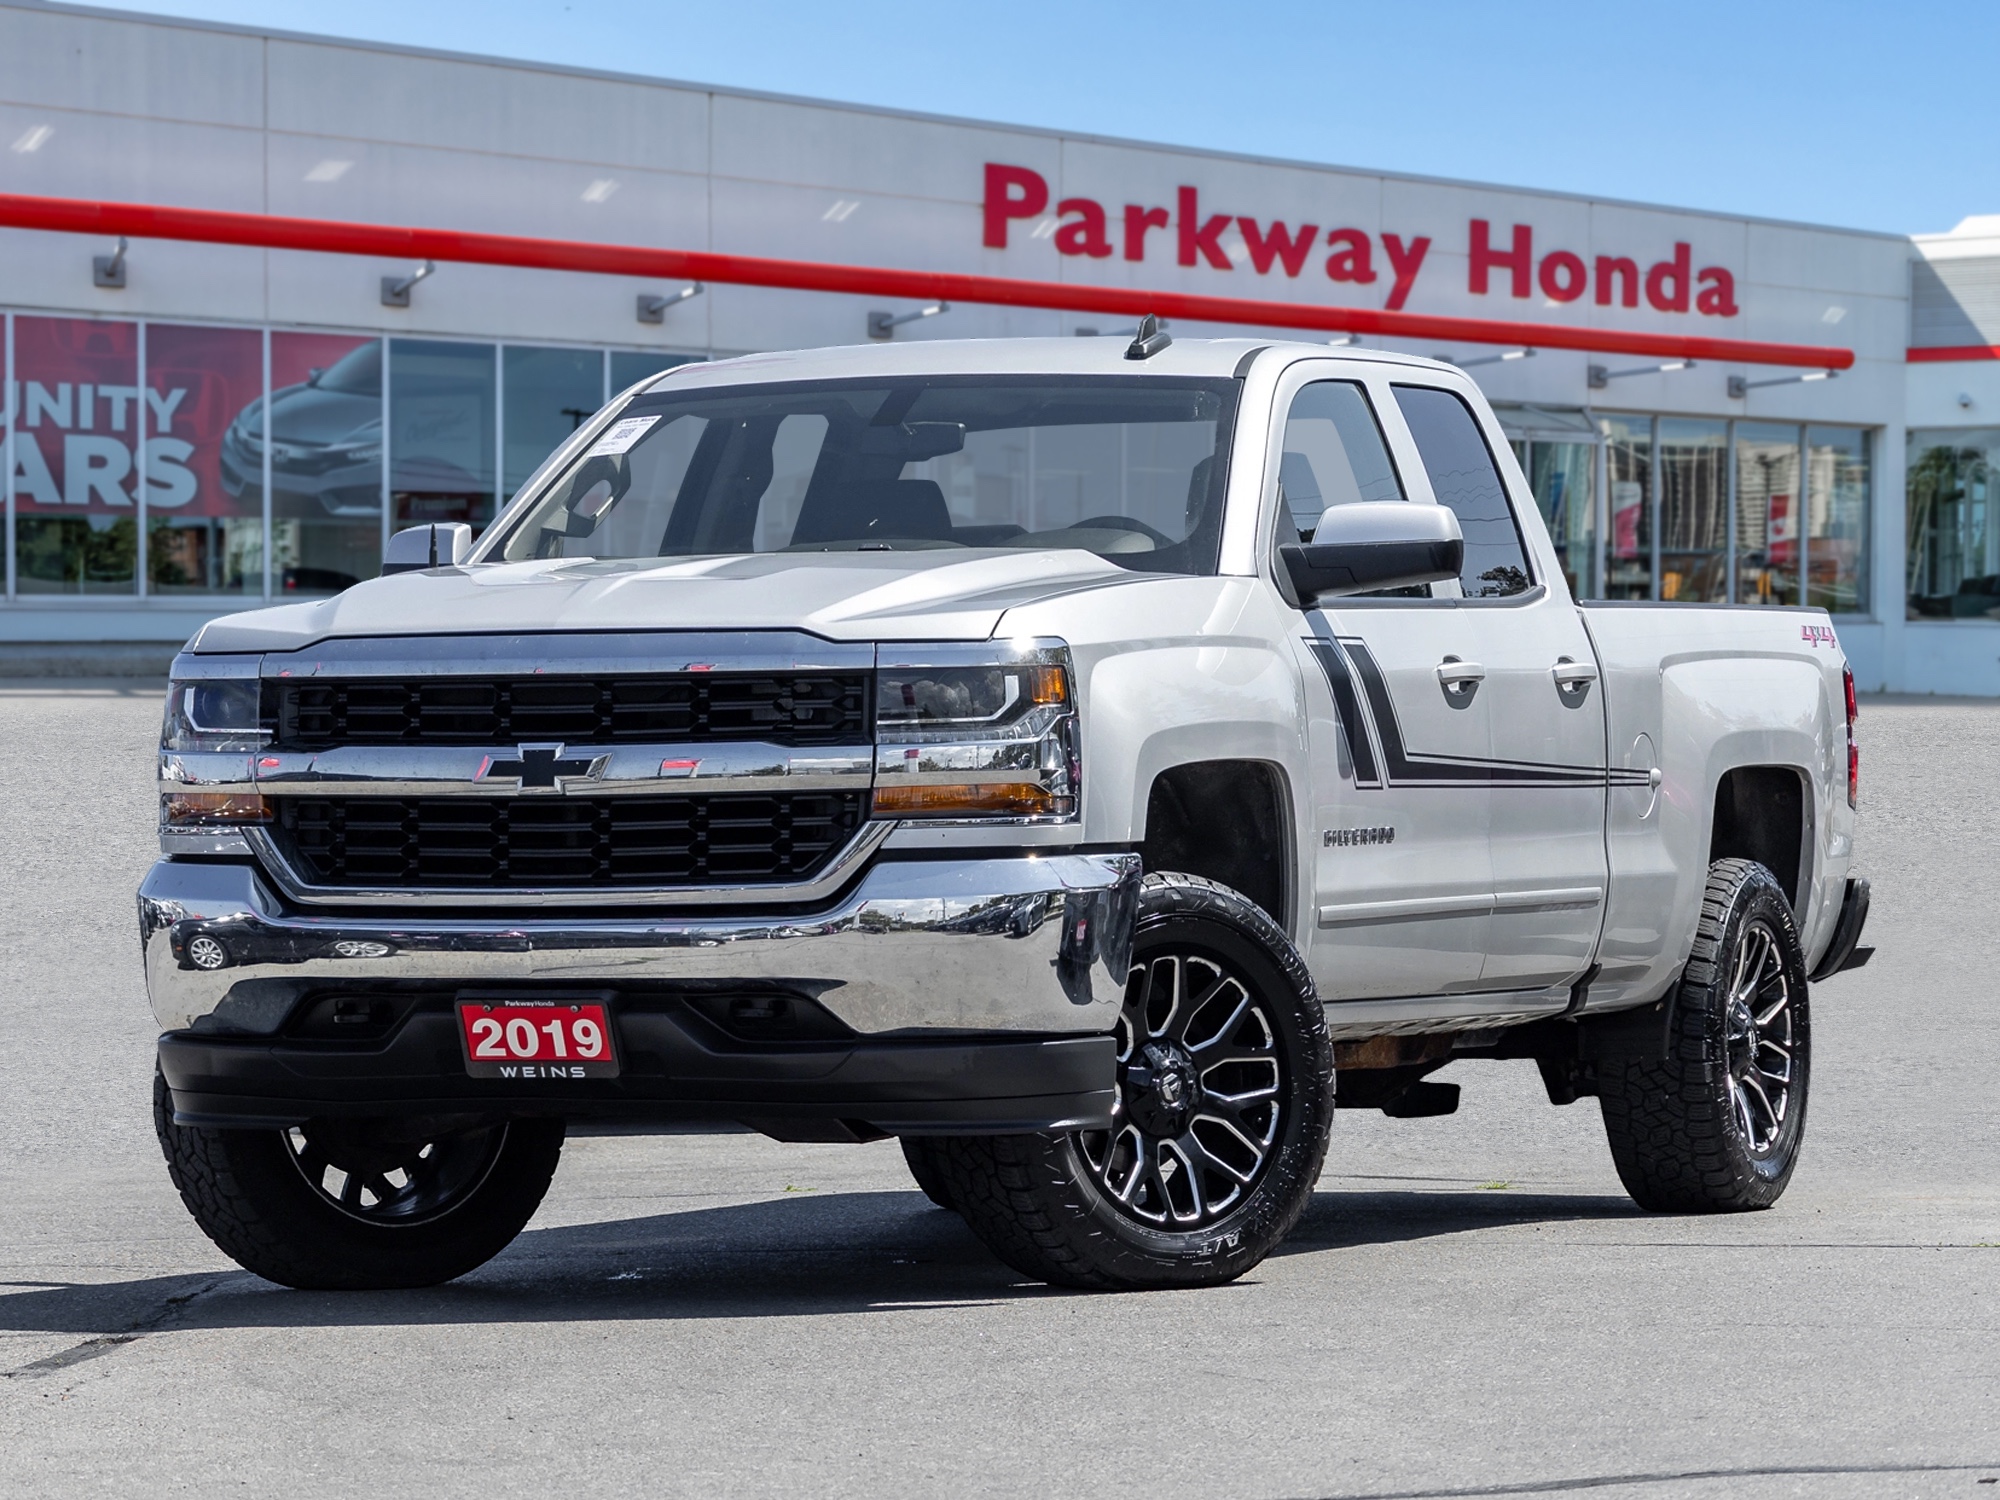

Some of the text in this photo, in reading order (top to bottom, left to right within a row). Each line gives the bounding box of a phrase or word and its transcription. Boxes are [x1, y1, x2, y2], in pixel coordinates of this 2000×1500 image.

[983, 162, 1739, 318] Parkway Honda
[472, 1018, 603, 1058] 2019
